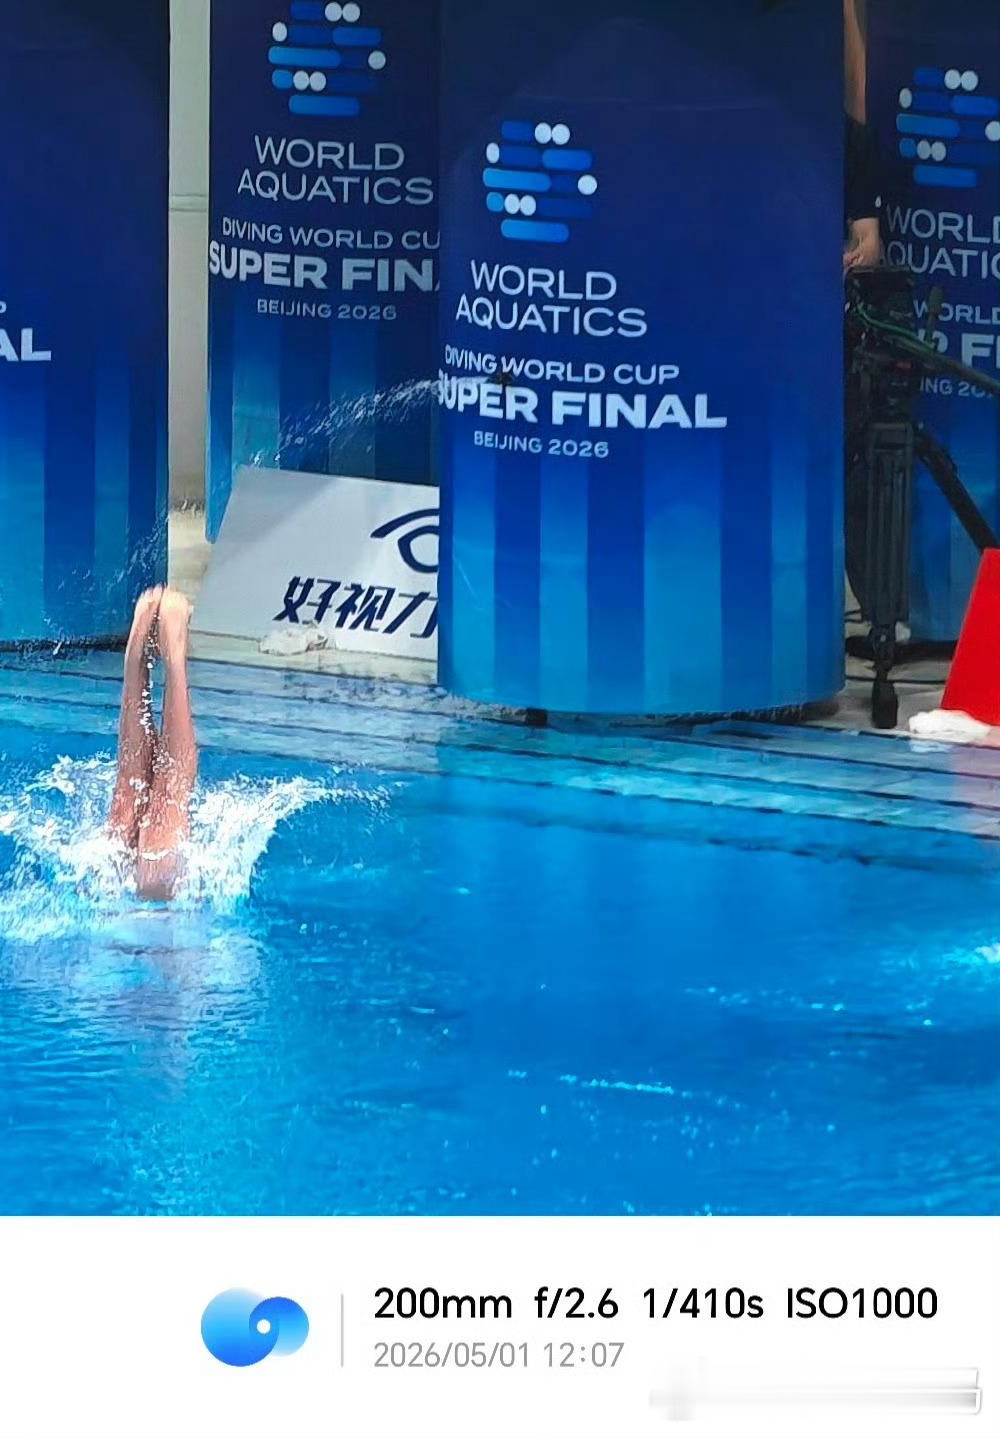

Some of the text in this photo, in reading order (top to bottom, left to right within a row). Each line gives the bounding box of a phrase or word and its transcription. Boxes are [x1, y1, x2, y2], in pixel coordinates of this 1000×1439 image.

[255, 135, 405, 171] WORLD
[237, 168, 434, 205] AQUATICS
[222, 216, 283, 244] DIVING
[289, 226, 394, 250] WORLD
[886, 204, 1000, 244] WORL
[209, 240, 440, 292] SUPER FIN
[471, 259, 617, 301] WORLD
[257, 298, 397, 320] BEIJING 2026
[456, 293, 647, 338] AQUATICS
[445, 344, 680, 385] DIVING WORLD CUP
[552, 391, 728, 429] FINAL
[474, 431, 609, 458] BEIJING 2026
[272, 576, 438, 638] 好视力
